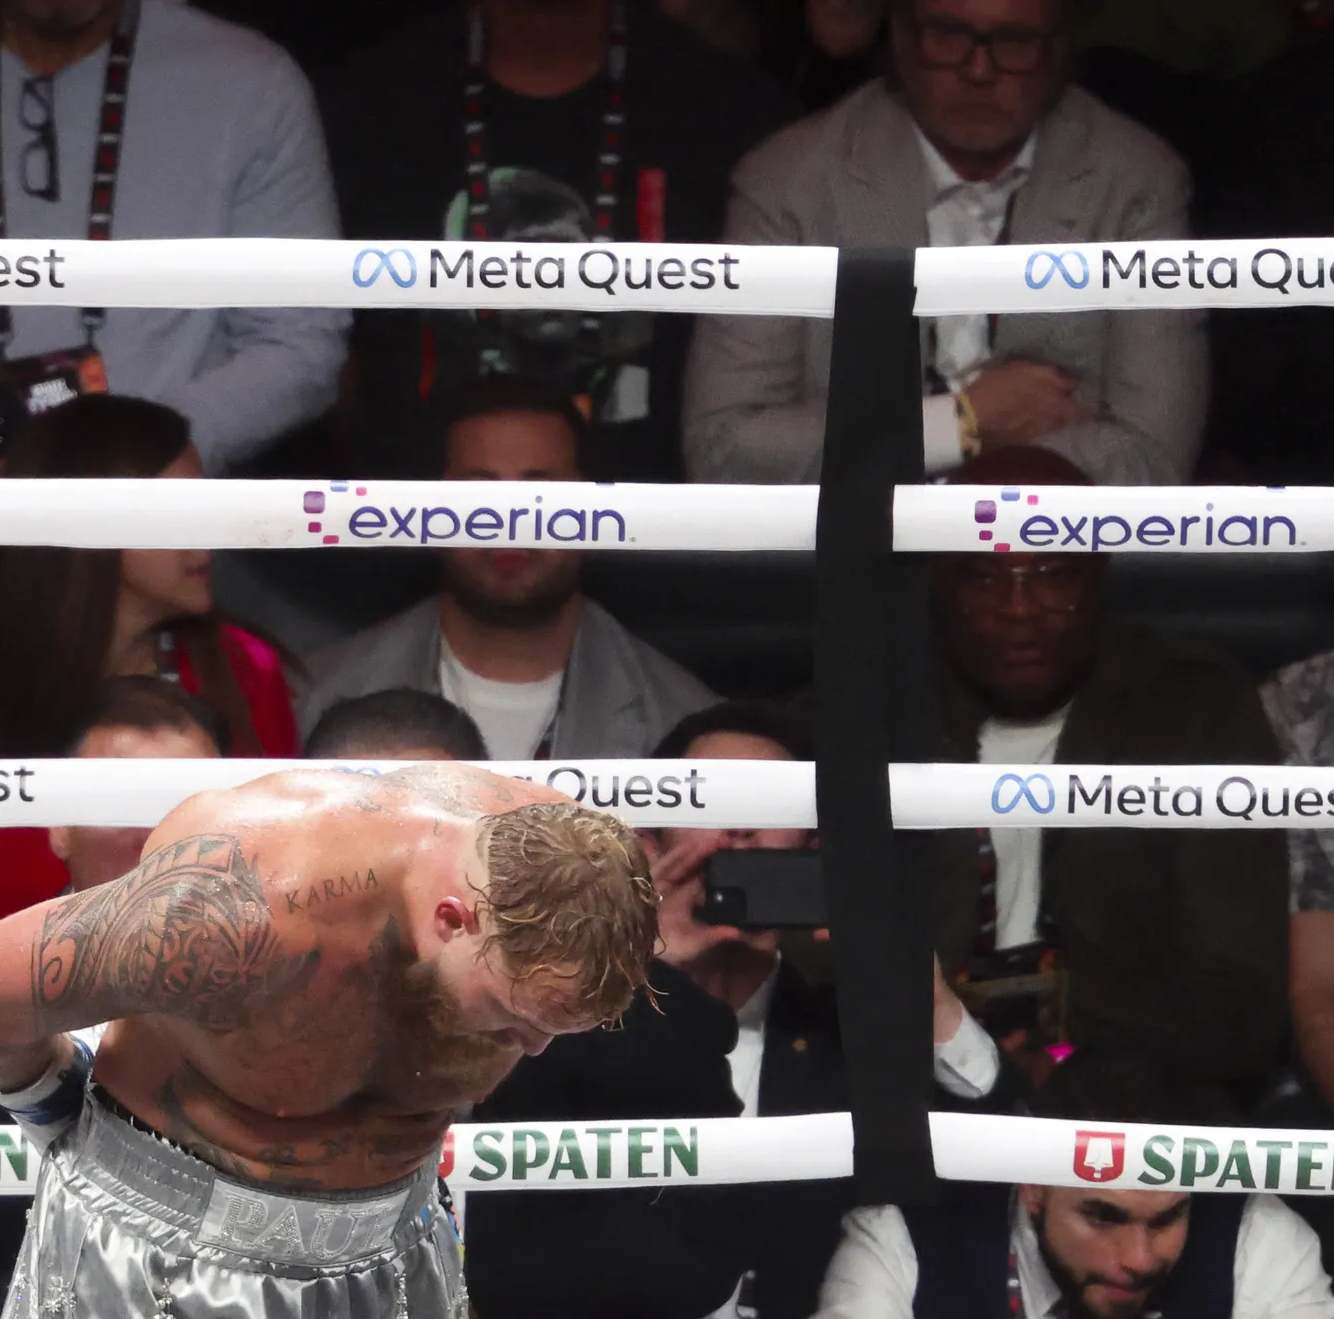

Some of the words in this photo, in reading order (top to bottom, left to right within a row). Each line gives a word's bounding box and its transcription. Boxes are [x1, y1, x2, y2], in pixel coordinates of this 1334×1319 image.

[430, 248, 564, 289] Meta
[578, 250, 739, 295] Quest
[1102, 250, 1237, 289] Meta
[348, 496, 625, 544] experian
[1020, 502, 1296, 550] experian
[546, 767, 706, 809] Quest
[1068, 775, 1202, 816] Meta
[285, 868, 381, 914] KARMA
[468, 1127, 698, 1181] SPATEN
[218, 1191, 395, 1260] PAUL
